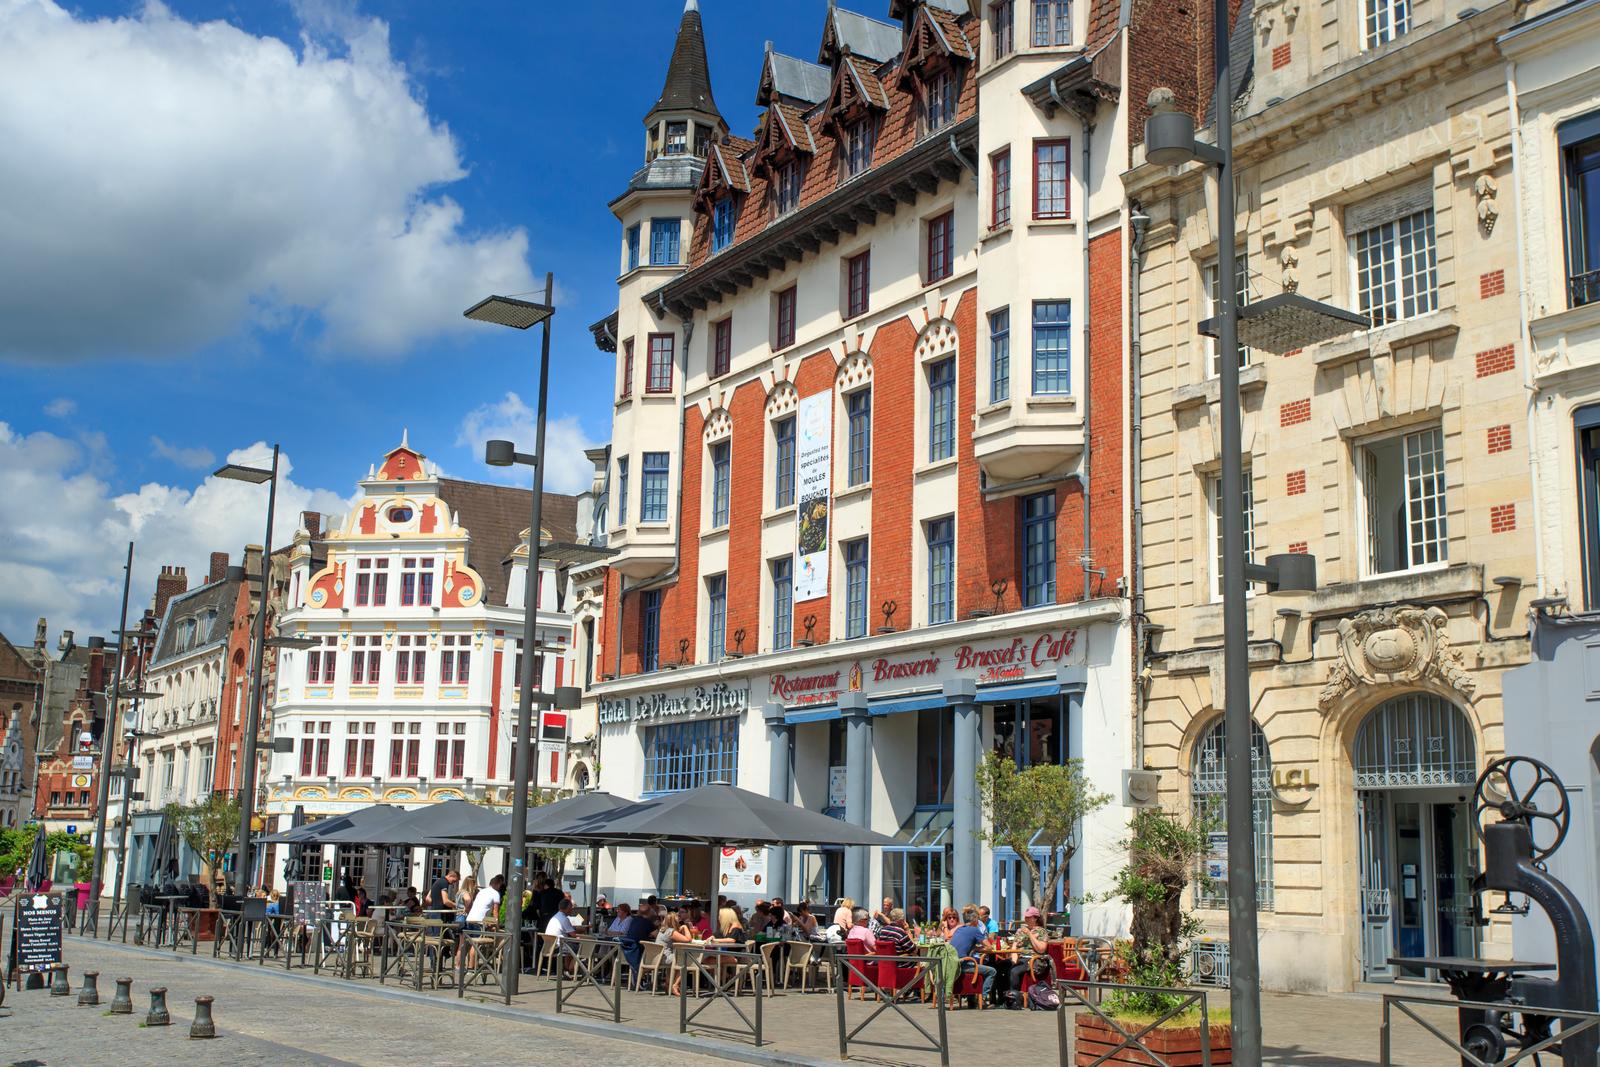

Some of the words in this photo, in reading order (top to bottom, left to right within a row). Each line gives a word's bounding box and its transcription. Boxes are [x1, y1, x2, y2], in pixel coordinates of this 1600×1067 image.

[803, 472, 826, 486] MOULES
[801, 488, 828, 503] BOUCHOT
[1031, 630, 1077, 668] Café
[872, 658, 940, 681] Brasserie
[771, 671, 841, 700] Restaurant
[633, 697, 651, 722] Le
[651, 693, 690, 717] Vieux
[691, 683, 749, 716] Beffroy
[1274, 768, 1310, 787] LCL
